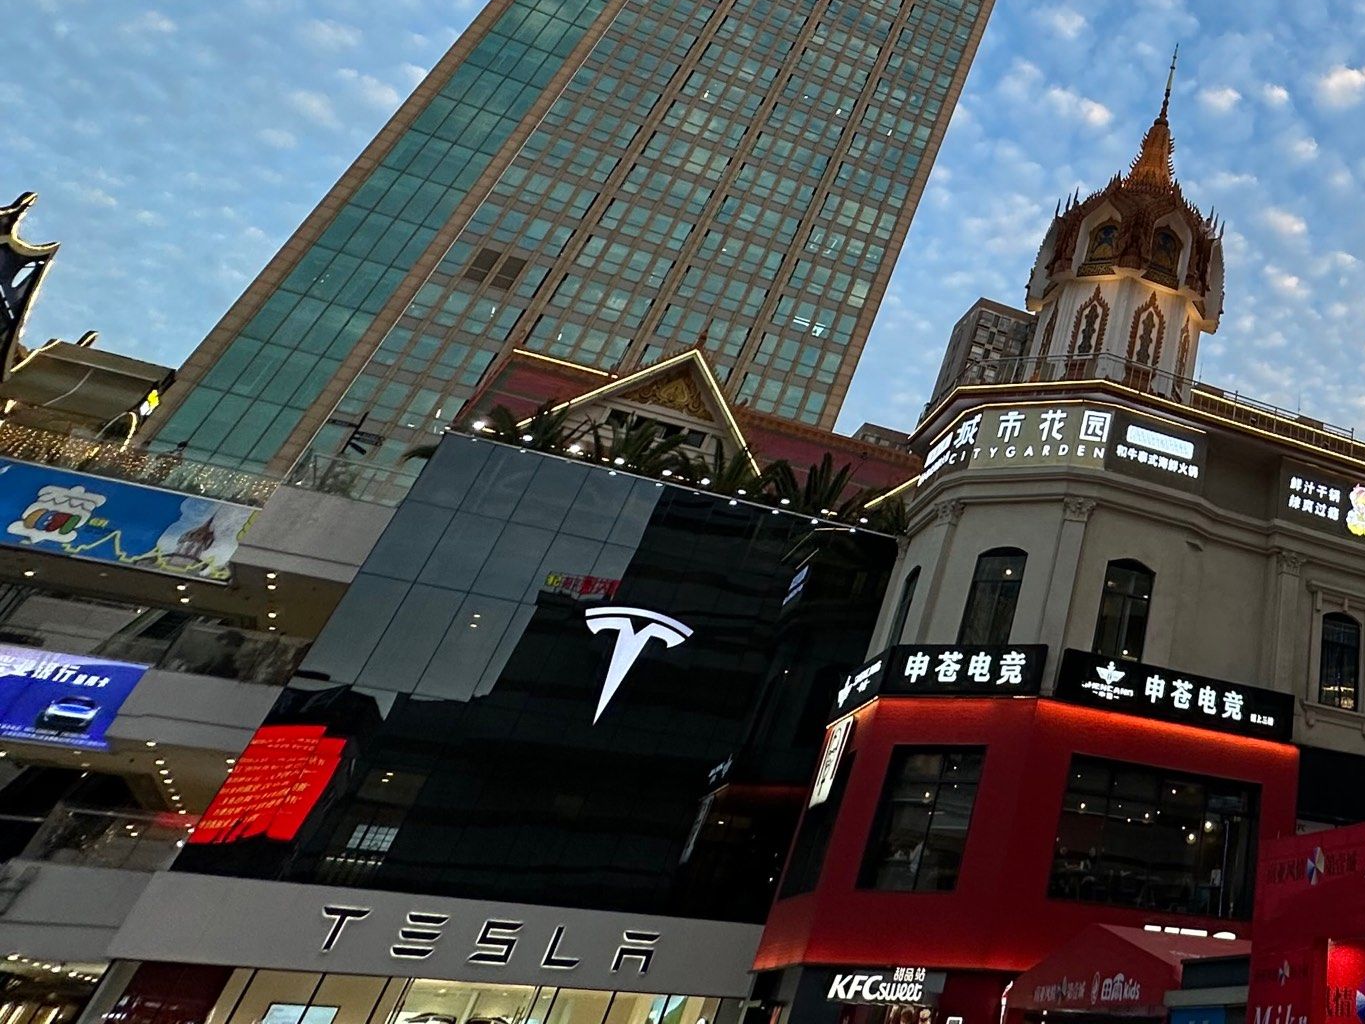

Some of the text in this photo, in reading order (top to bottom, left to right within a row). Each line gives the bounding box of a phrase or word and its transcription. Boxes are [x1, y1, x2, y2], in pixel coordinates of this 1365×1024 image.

[953, 410, 1113, 446] 城市花园
[1290, 476, 1341, 504] 鲜汁干锅
[1288, 494, 1340, 522] 辣爽过瘾
[904, 650, 1027, 685] 申苍电竞
[1144, 674, 1244, 721] 申苍电竞
[322, 905, 661, 975] TESLA
[893, 967, 926, 982] 甜品站
